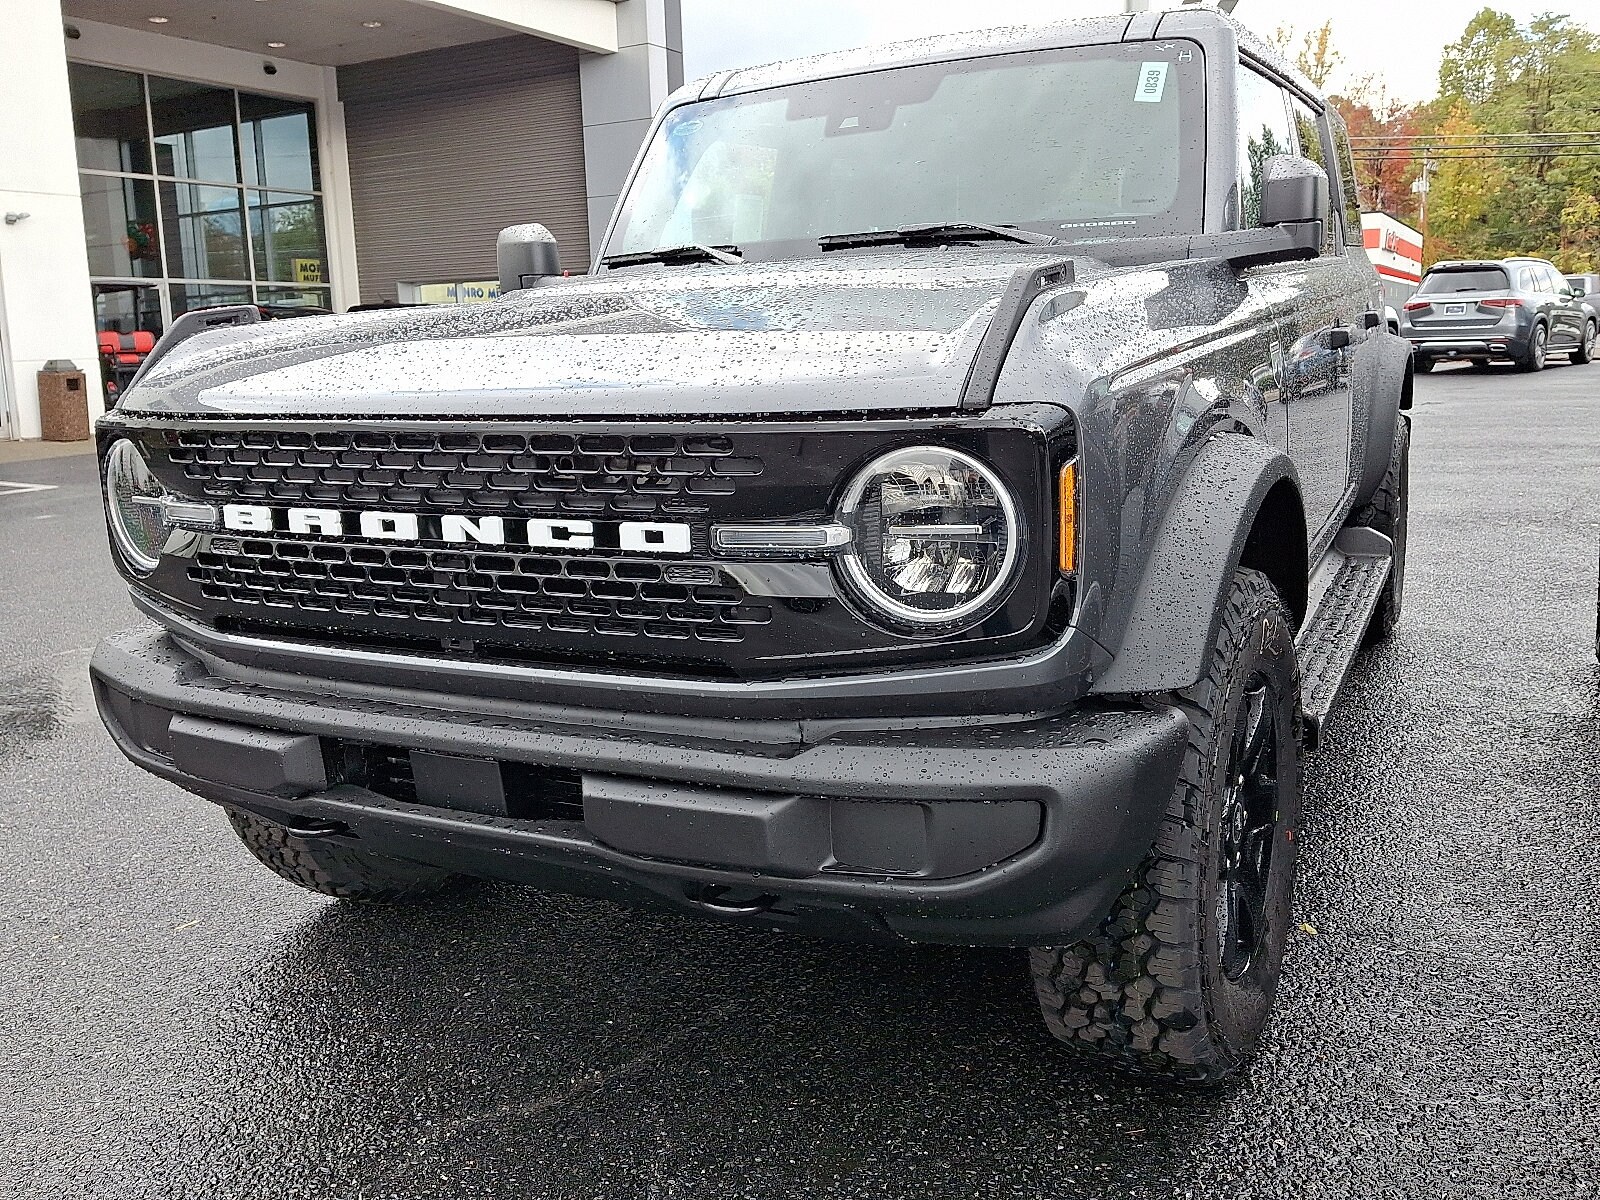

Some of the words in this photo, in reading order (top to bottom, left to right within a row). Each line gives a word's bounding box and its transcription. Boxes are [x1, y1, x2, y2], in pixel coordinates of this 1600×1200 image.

[1060, 220, 1137, 229] BRONCO
[446, 286, 484, 298] MNRO
[223, 504, 692, 554] BRONCO
